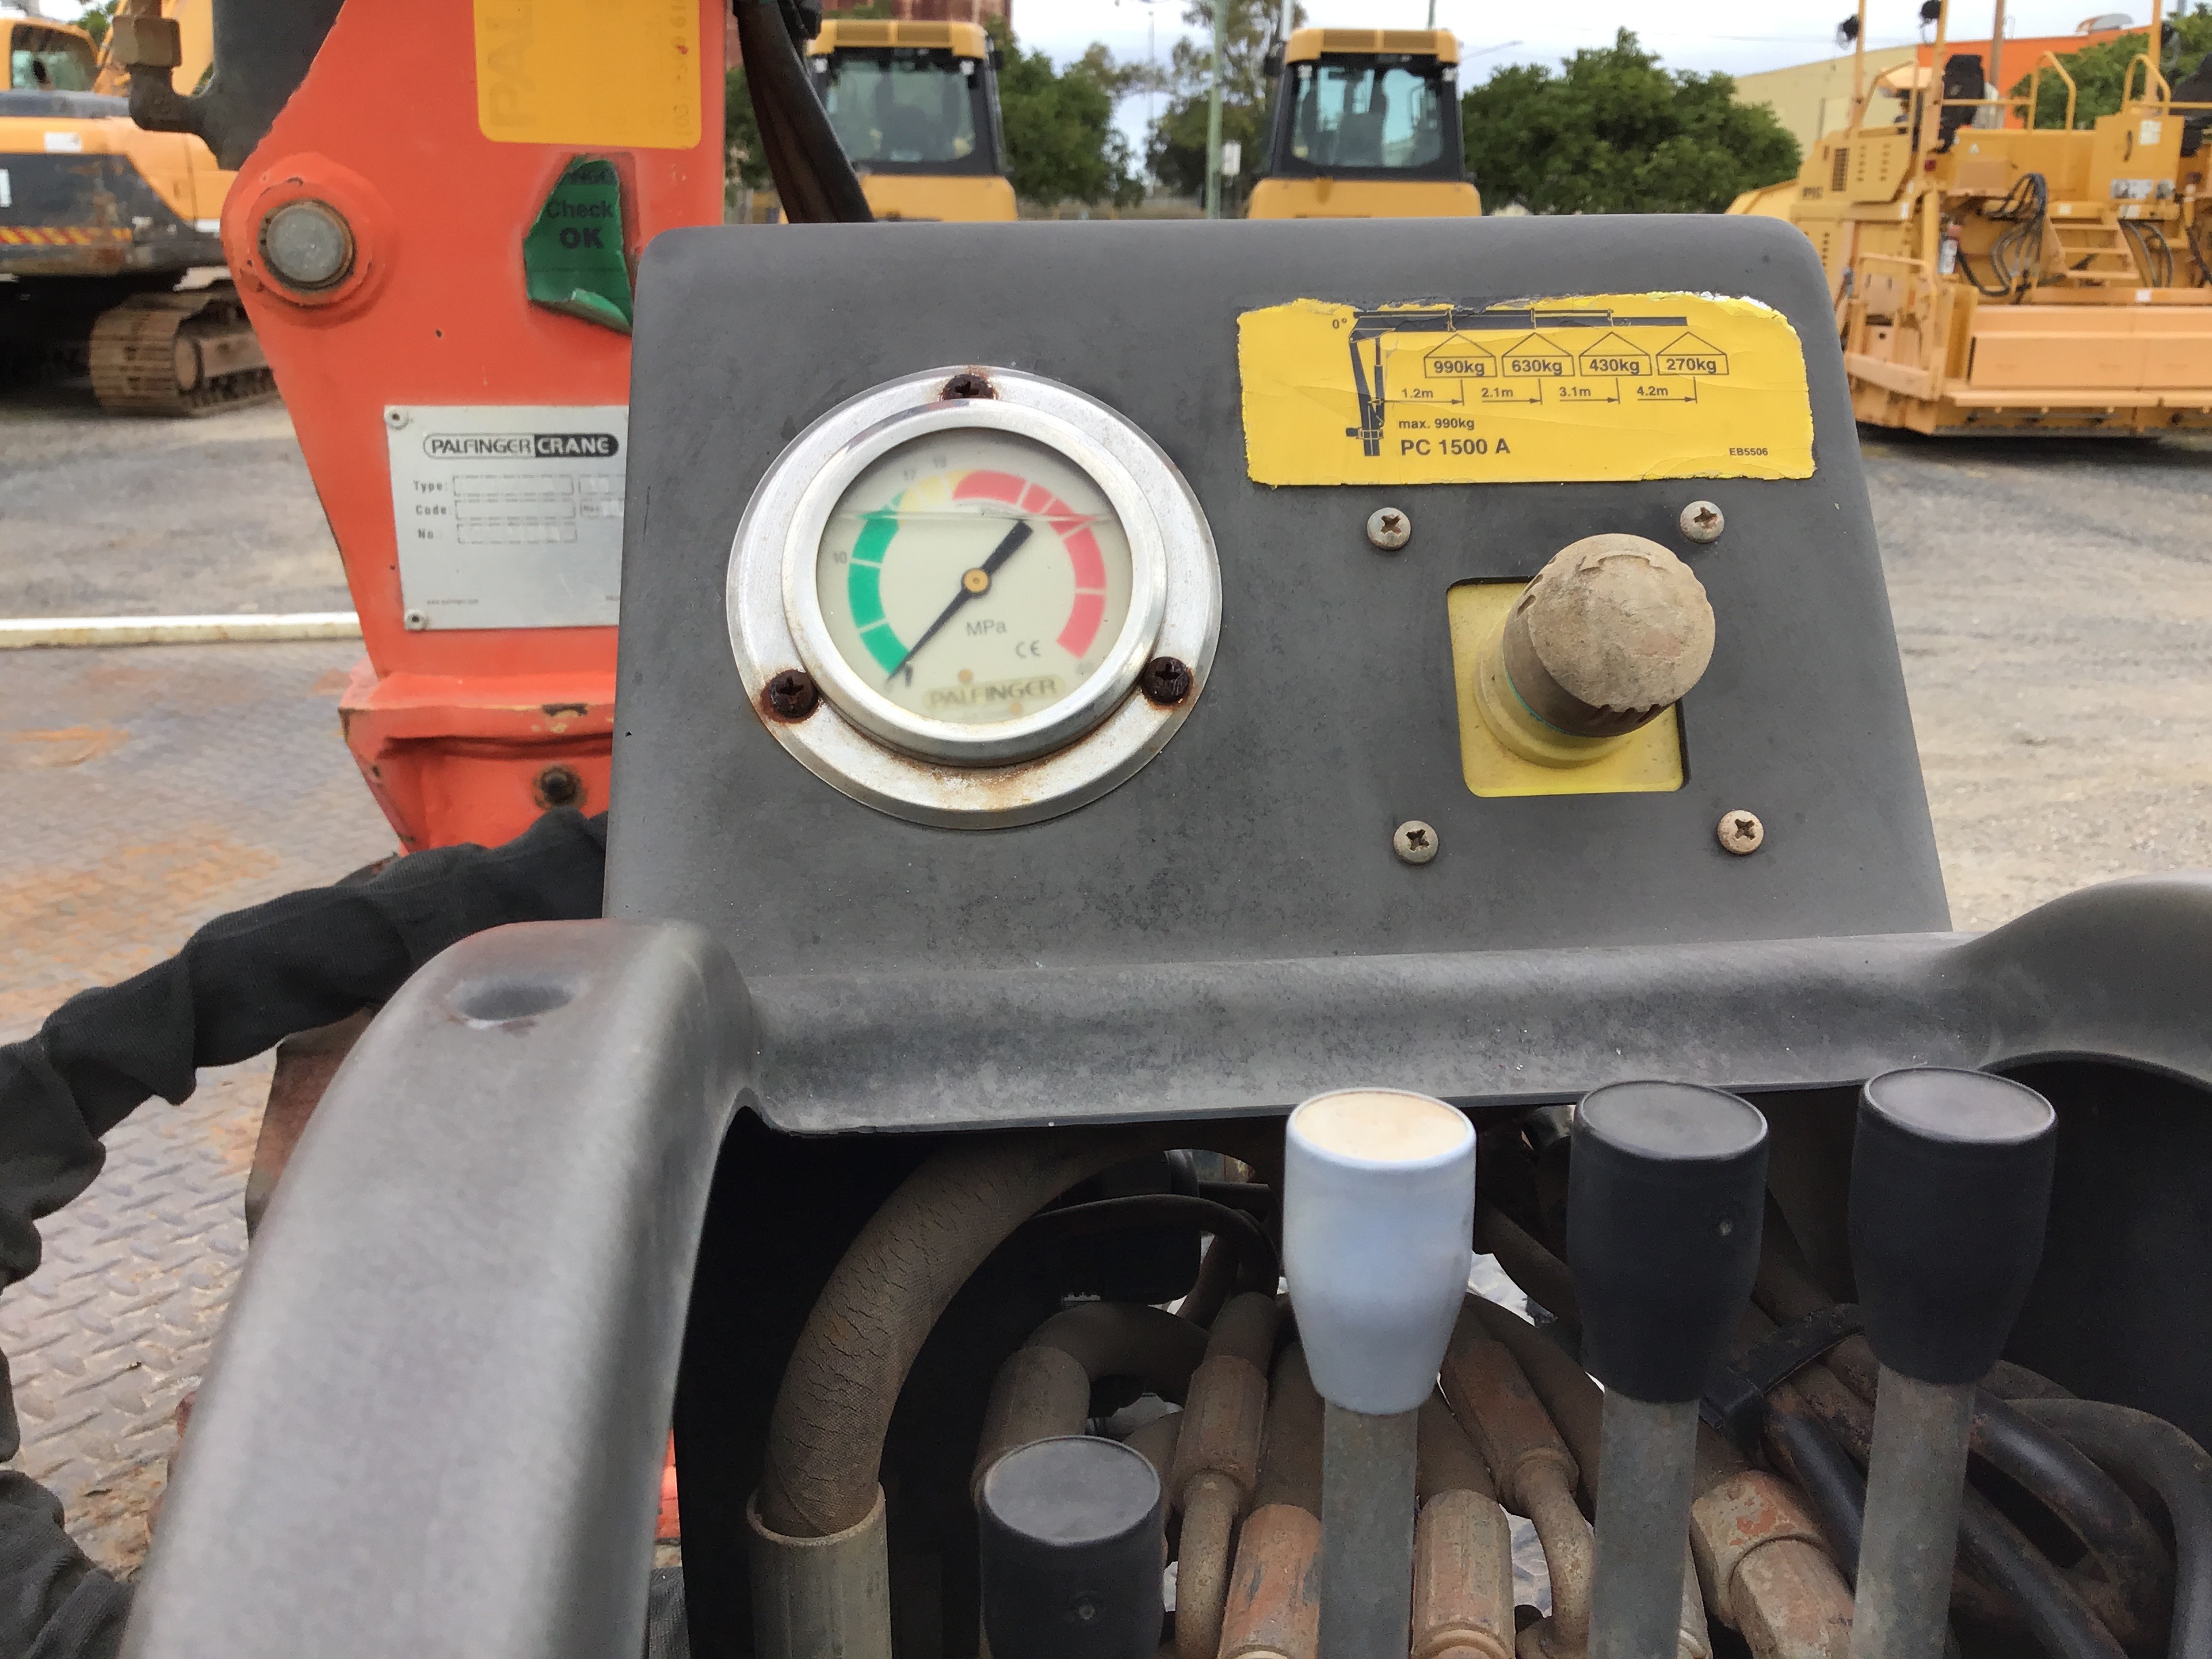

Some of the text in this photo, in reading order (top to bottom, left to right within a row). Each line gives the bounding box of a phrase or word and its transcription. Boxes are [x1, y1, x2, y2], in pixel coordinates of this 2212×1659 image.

[546, 199, 614, 219] Check
[559, 227, 604, 249] OK
[1433, 357, 1717, 377] 990kg 630kg 430kg 270kg
[1401, 385, 1668, 398] 1.2m 2.1m 3.1m 4.2m
[1398, 417, 1475, 431] max. 990kg
[430, 436, 610, 455] PALFINGER CRANE
[1401, 437, 1511, 456] PC 1500 A
[1729, 447, 1769, 457] EB5506
[966, 619, 1007, 636] MPa
